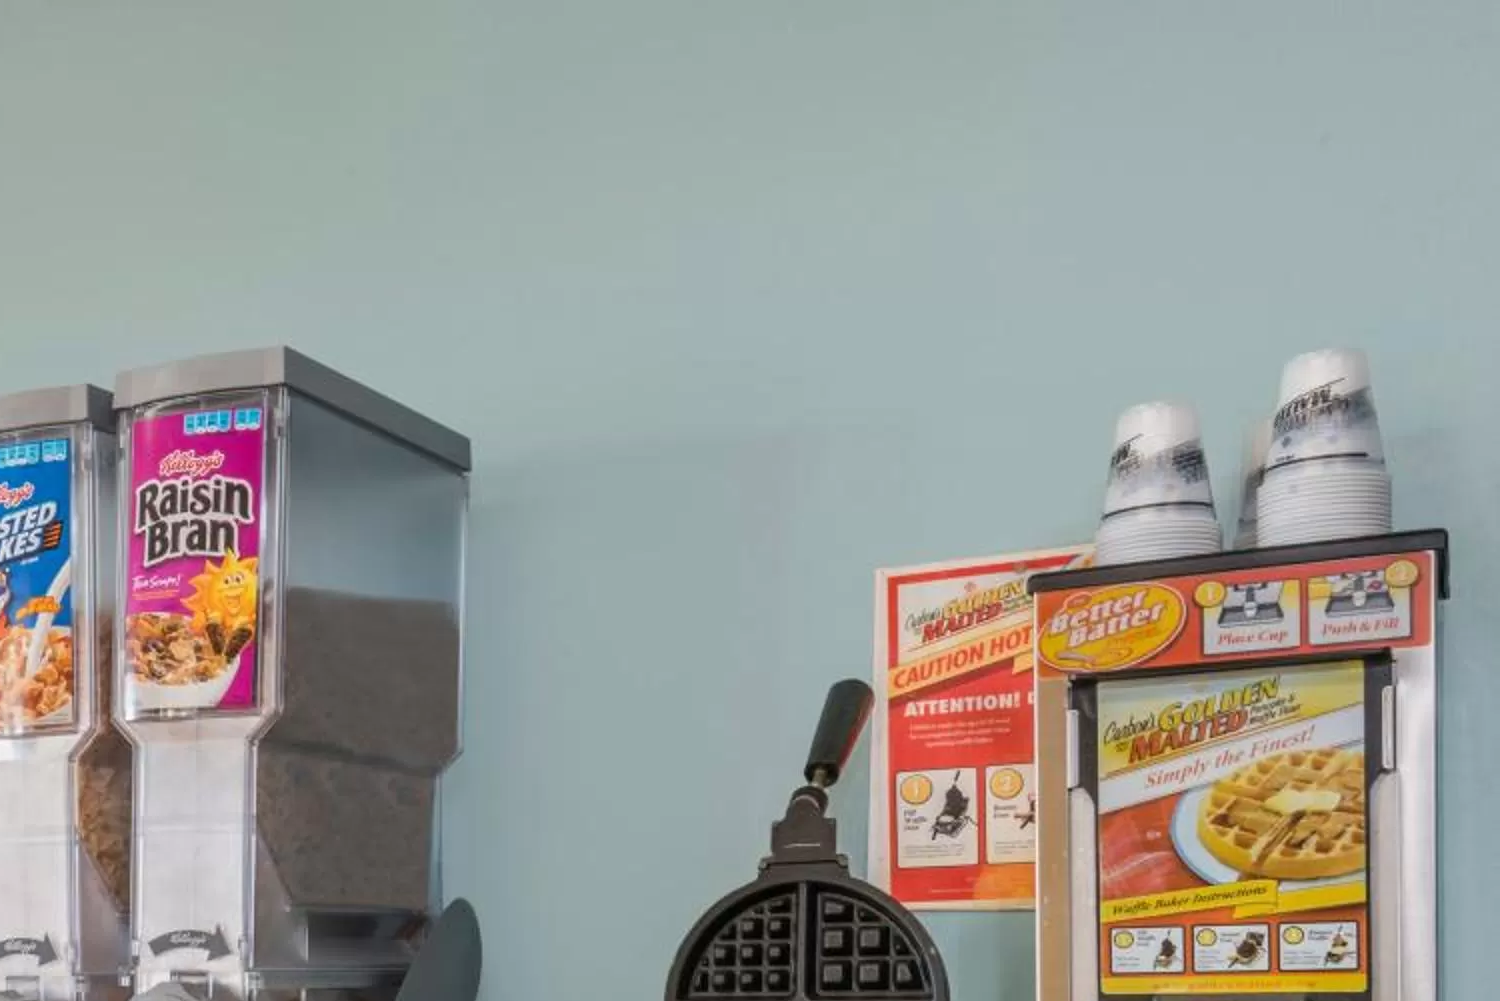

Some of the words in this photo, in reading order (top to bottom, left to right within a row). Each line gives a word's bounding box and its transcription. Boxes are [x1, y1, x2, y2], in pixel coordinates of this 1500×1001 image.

[138, 478, 251, 531] Raisin
[147, 518, 236, 563] Bran
[1051, 590, 1148, 633] Better
[1068, 604, 1165, 647] Batter
[1321, 622, 1357, 636] Push
[1218, 631, 1254, 646] Place
[1257, 629, 1288, 645] Cup
[894, 642, 985, 689] CAUTION
[904, 691, 1021, 717] ATTENTION!
[1157, 674, 1281, 733] GOLDEN
[1128, 709, 1248, 763] MALTED
[1144, 758, 1206, 790] Simply
[1215, 750, 1245, 769] the
[1250, 723, 1316, 758] Finest!
[1112, 901, 1152, 916] Waffle
[1154, 895, 1189, 910] Baker
[1191, 886, 1268, 905] Instructions
